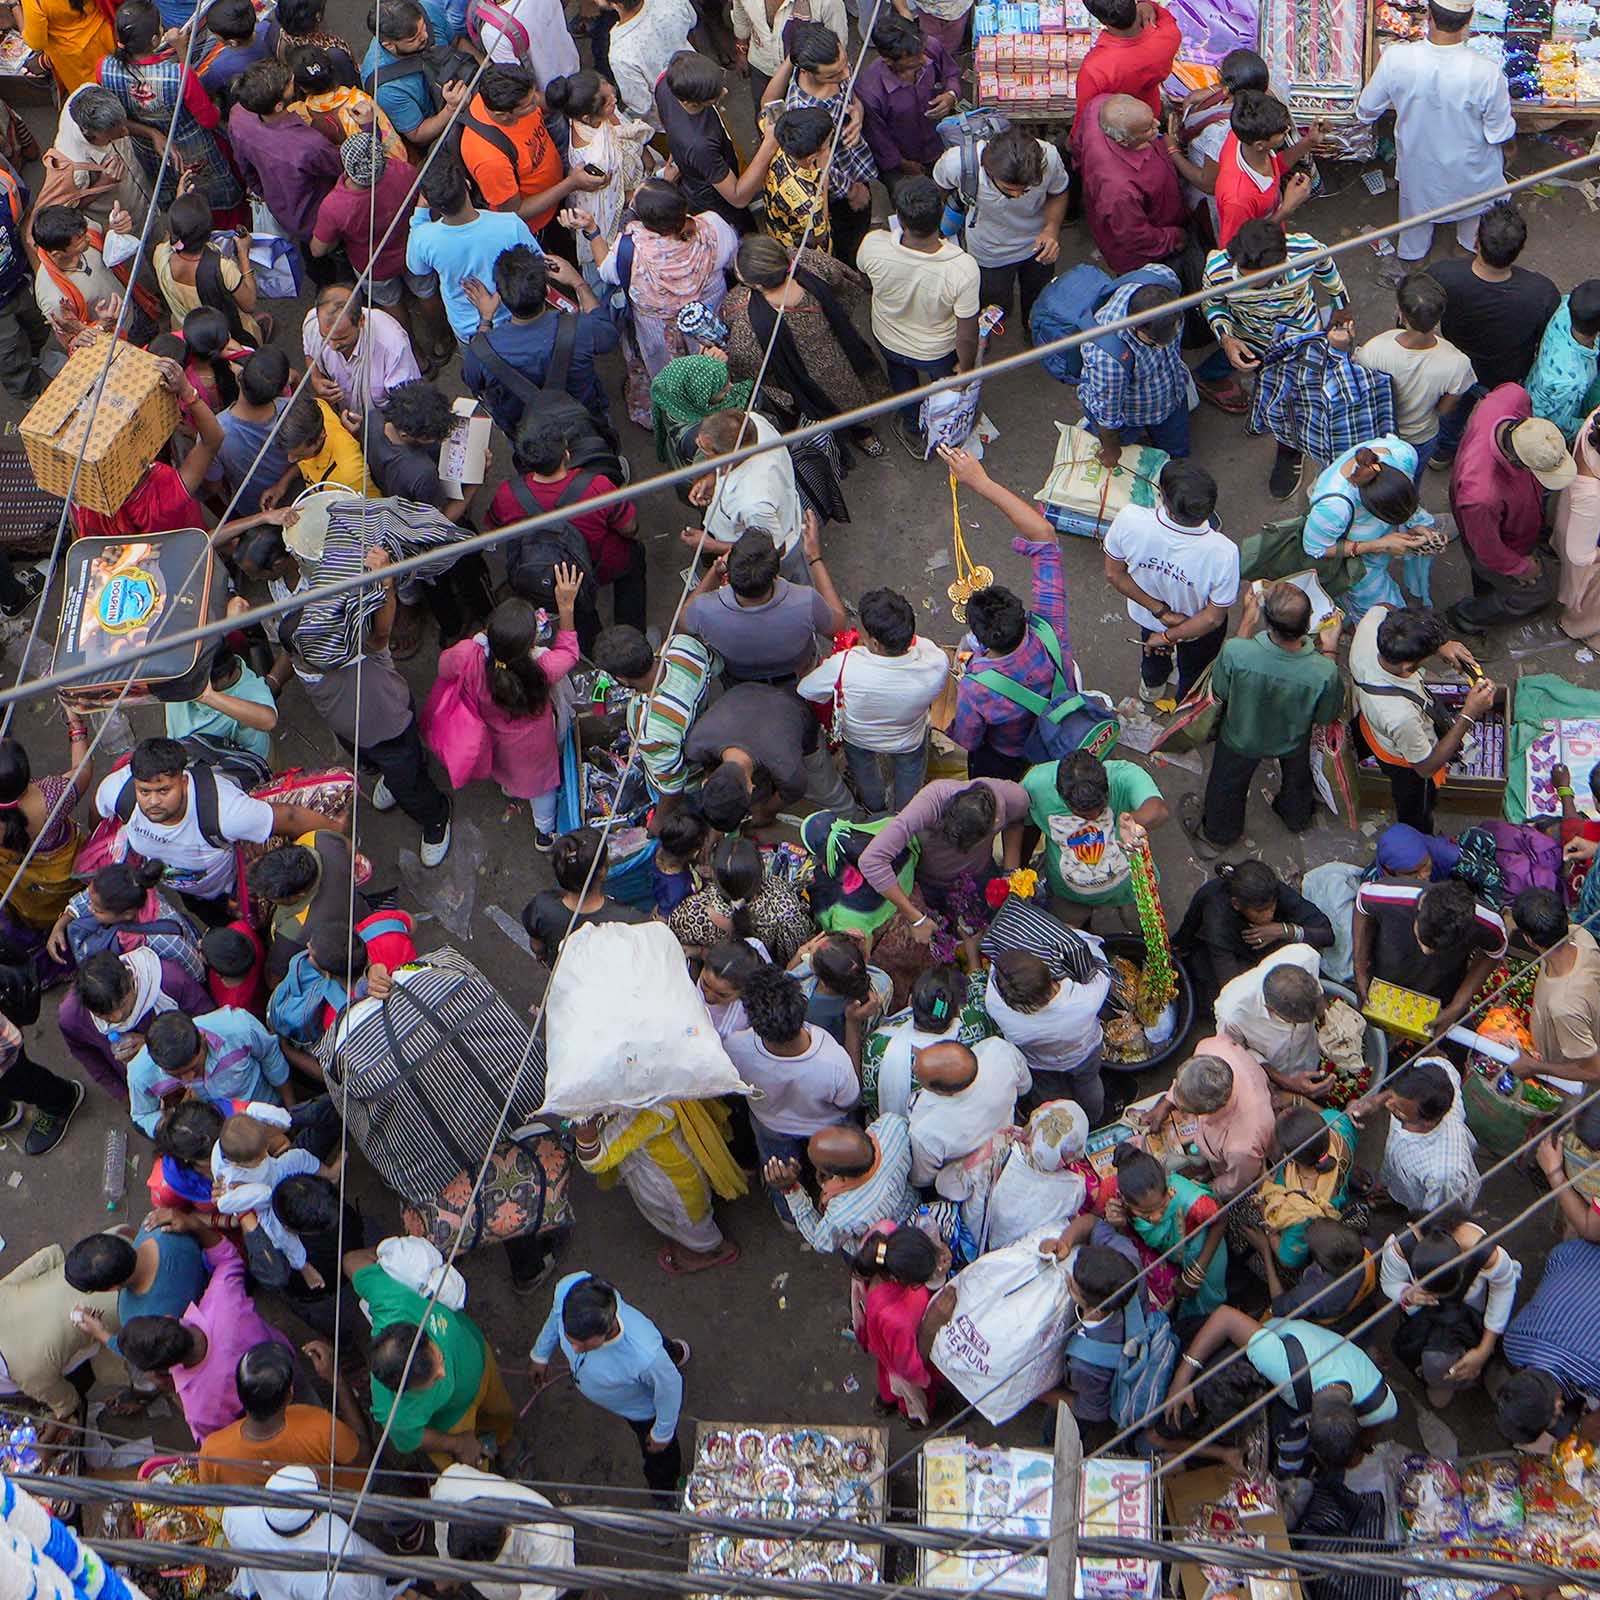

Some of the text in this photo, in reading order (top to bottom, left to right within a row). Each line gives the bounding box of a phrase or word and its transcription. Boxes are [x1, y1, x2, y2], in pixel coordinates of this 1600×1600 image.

[1138, 562, 1195, 587] DEFENCE
[1149, 556, 1188, 580] CIVIL
[109, 580, 123, 623] DOLPHIN
[133, 825, 170, 845] artistry
